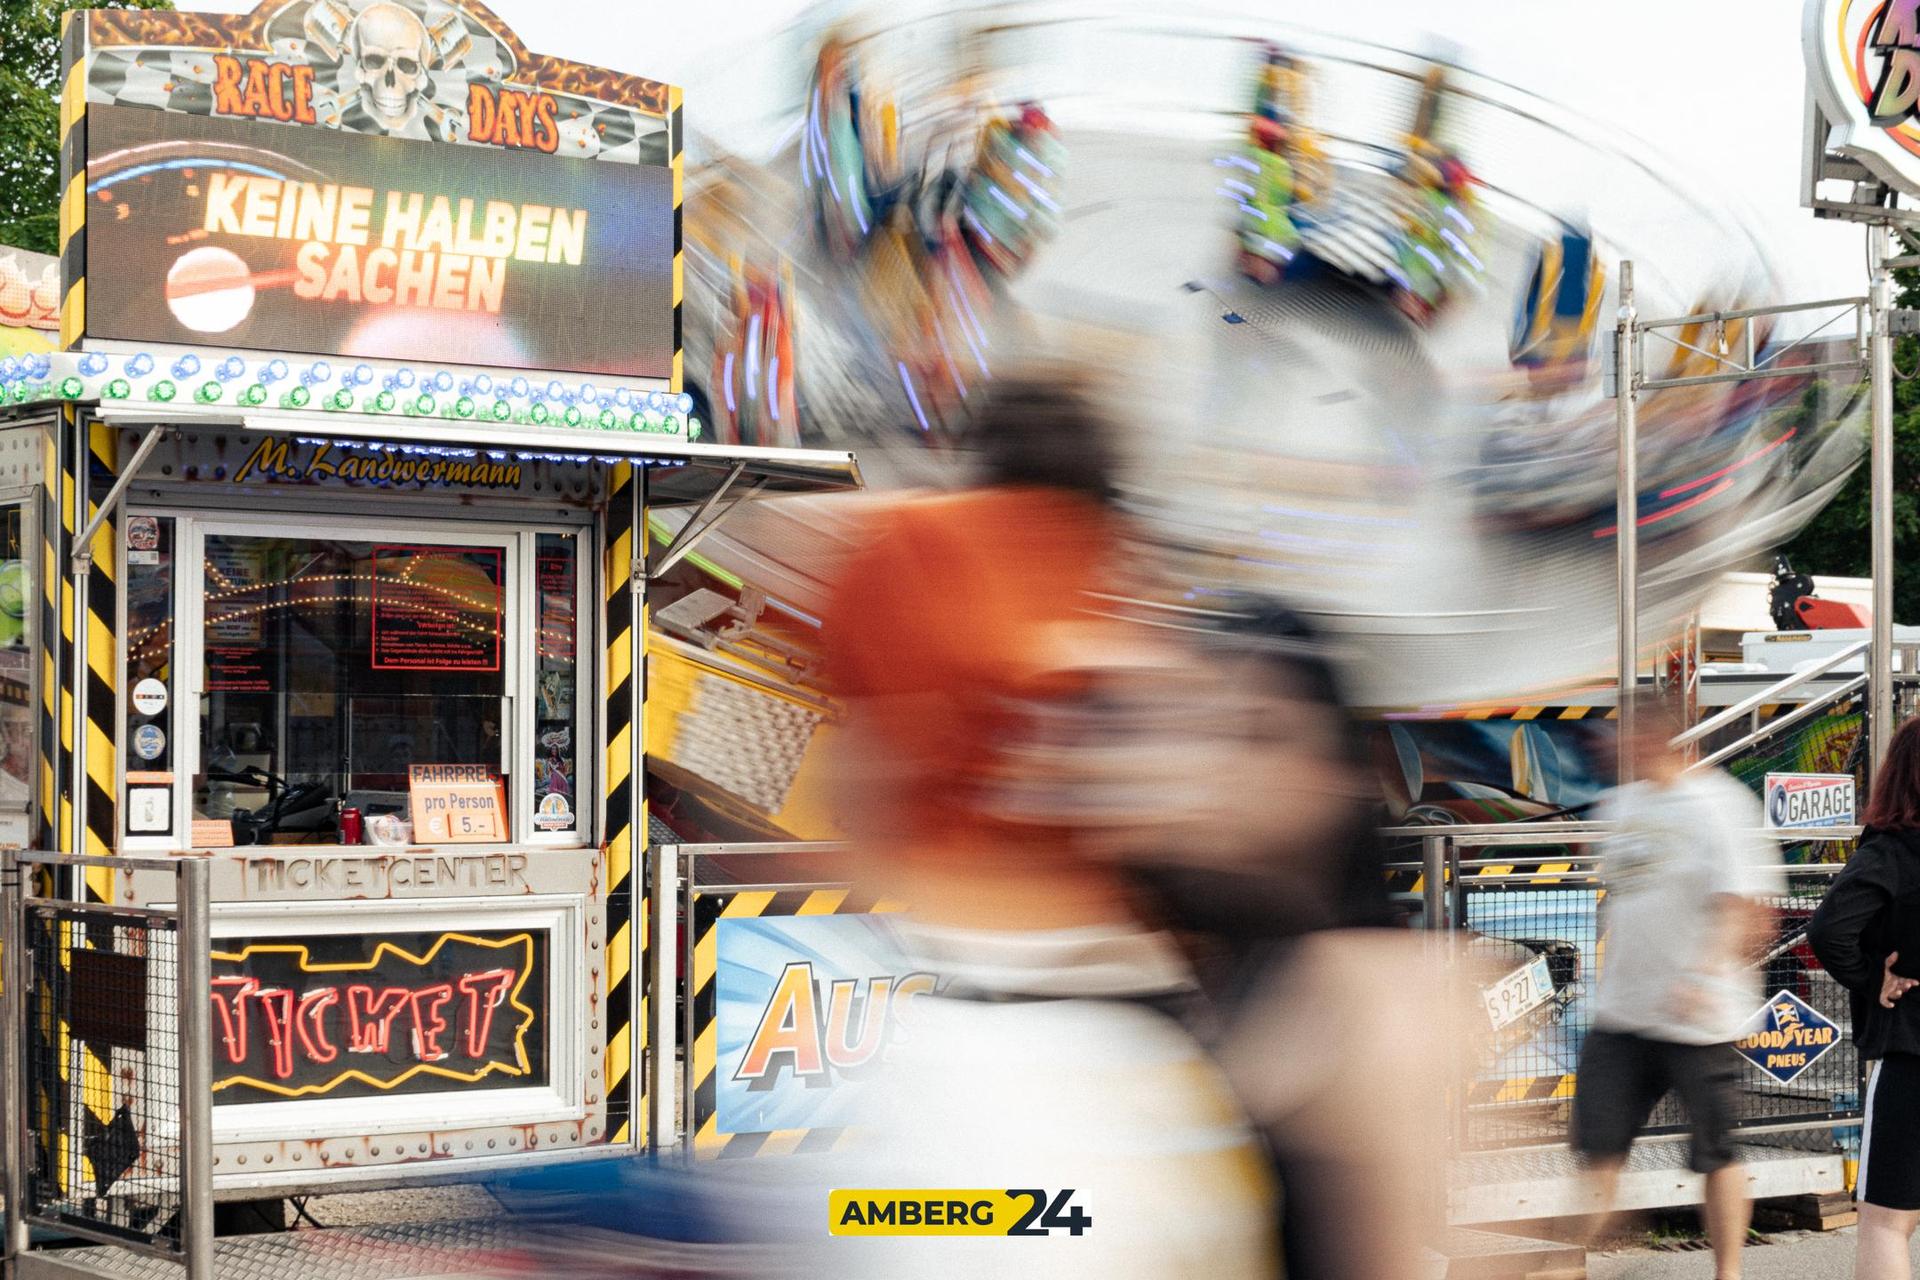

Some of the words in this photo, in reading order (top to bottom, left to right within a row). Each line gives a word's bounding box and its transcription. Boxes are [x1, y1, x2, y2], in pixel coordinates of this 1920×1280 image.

[213, 54, 317, 124] RACE
[467, 83, 560, 154] DAYS
[203, 172, 375, 246] KEINE
[381, 189, 589, 266] HALBEN
[294, 240, 508, 314] SACHEN
[234, 435, 296, 483] M.
[305, 440, 521, 489] Landwermann
[412, 765, 500, 783] FAHRPREIS
[425, 796, 446, 813] pro
[450, 793, 494, 810] Person
[1788, 784, 1851, 822] GARAGE
[210, 969, 516, 1079] TICKET
[1766, 1053, 1807, 1069] PNEUS
